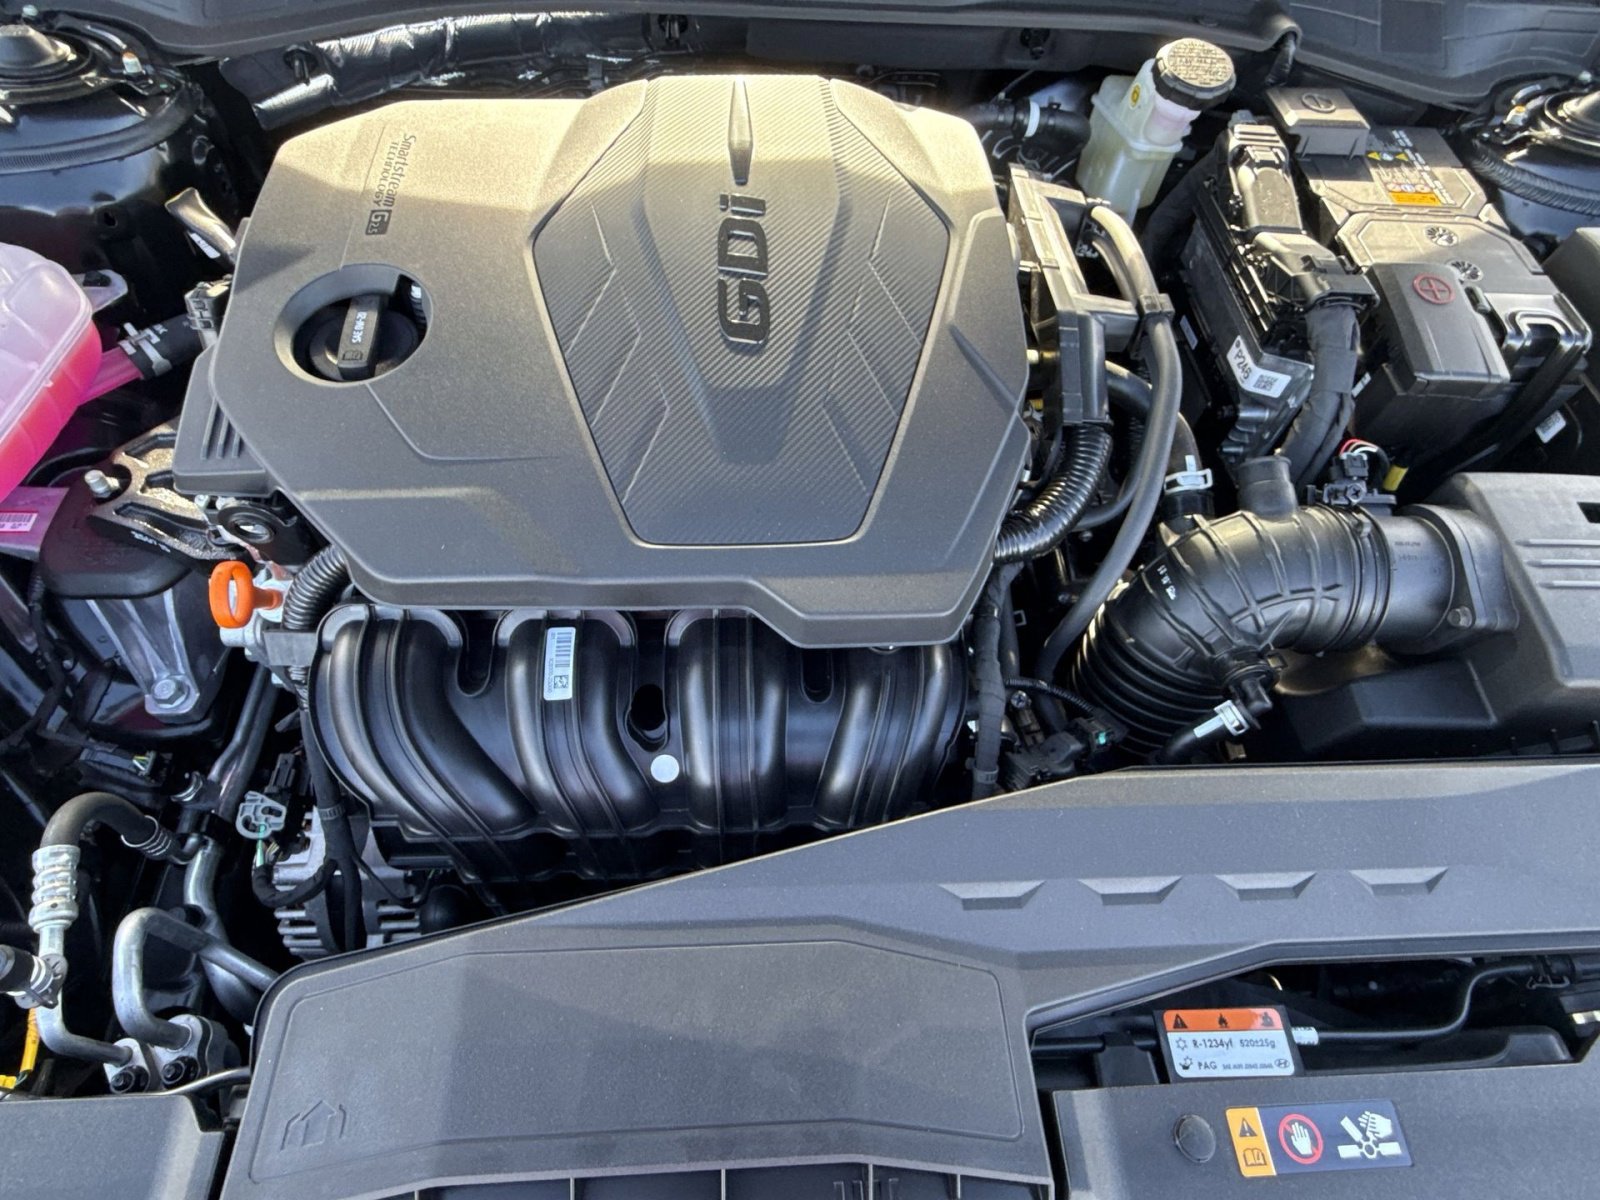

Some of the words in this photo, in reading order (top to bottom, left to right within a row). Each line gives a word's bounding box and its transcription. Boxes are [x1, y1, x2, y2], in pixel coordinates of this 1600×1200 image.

[373, 141, 399, 207] TECHNOLOGY
[383, 134, 417, 207] Smartstream
[717, 193, 770, 344] GDi
[351, 330, 364, 343] SAE
[1198, 1061, 1217, 1070] PAG
